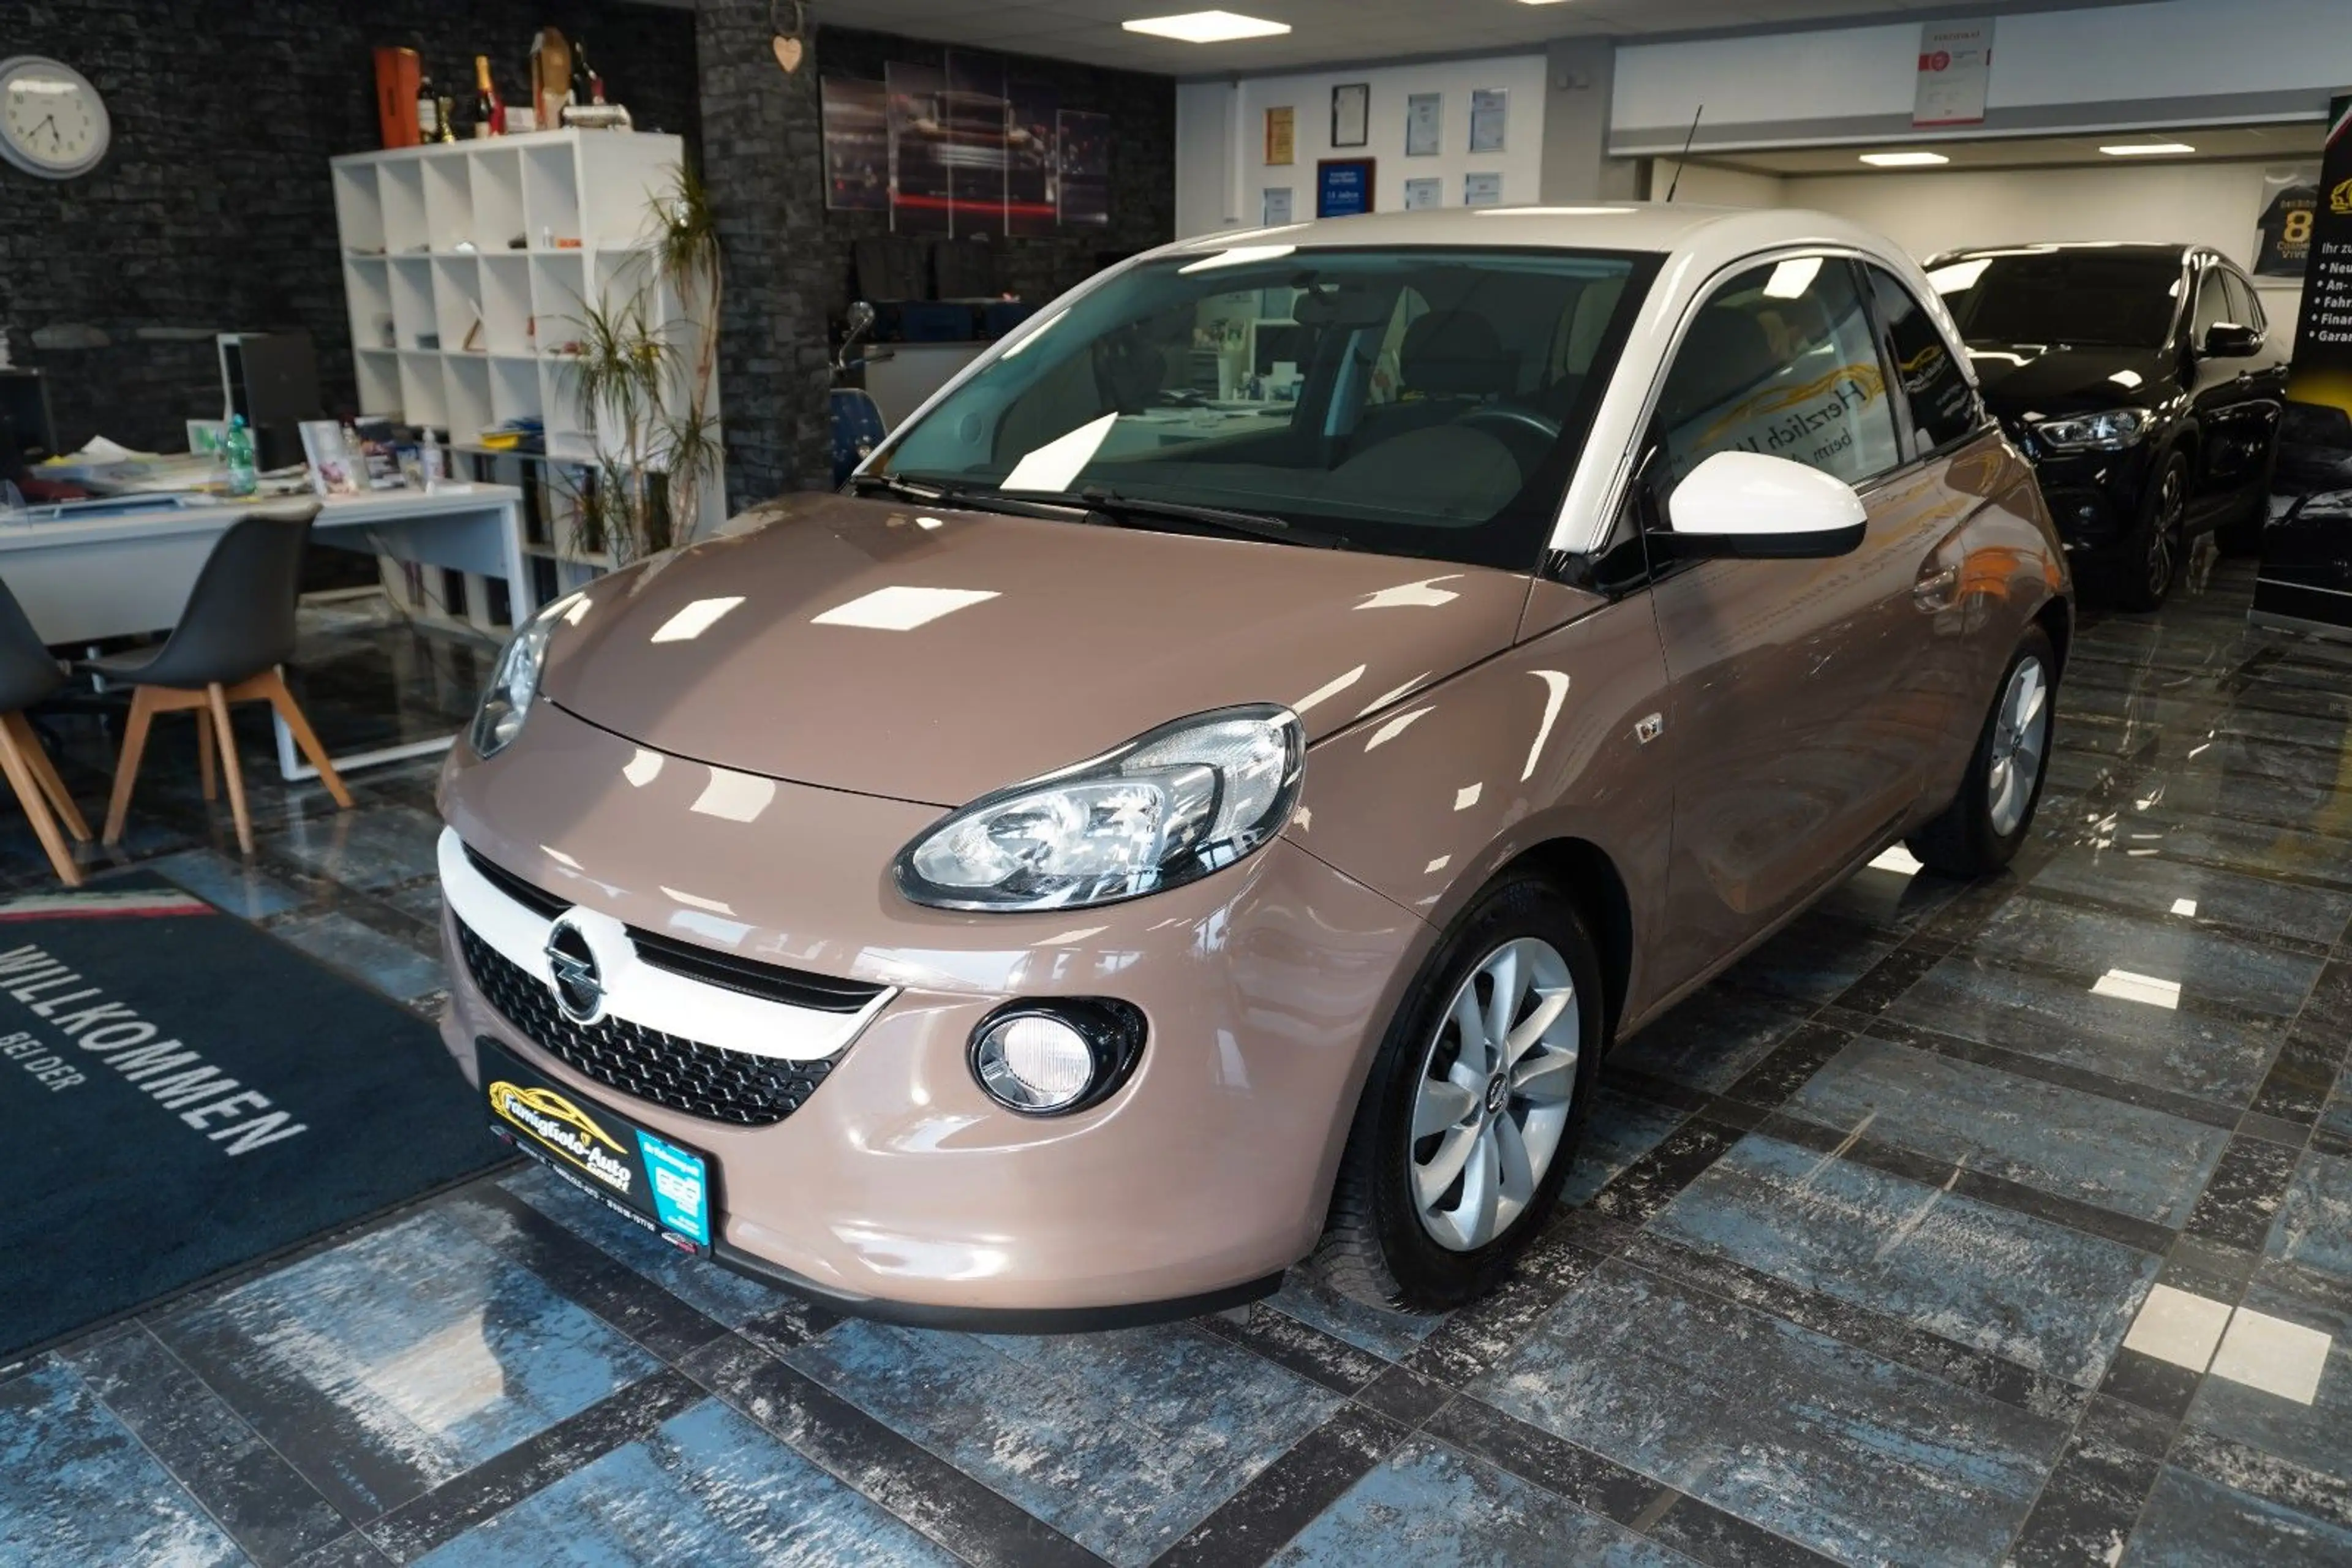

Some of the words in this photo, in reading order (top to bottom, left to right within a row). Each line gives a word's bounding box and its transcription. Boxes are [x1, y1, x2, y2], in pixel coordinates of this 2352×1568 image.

[2284, 210, 2313, 243] 8
[2322, 242, 2339, 254] Ihr
[2329, 262, 2352, 273] Neu
[0, 1031, 48, 1060] BEI
[0, 944, 308, 1156] WILLKOMMEN
[23, 1055, 86, 1092] DER
